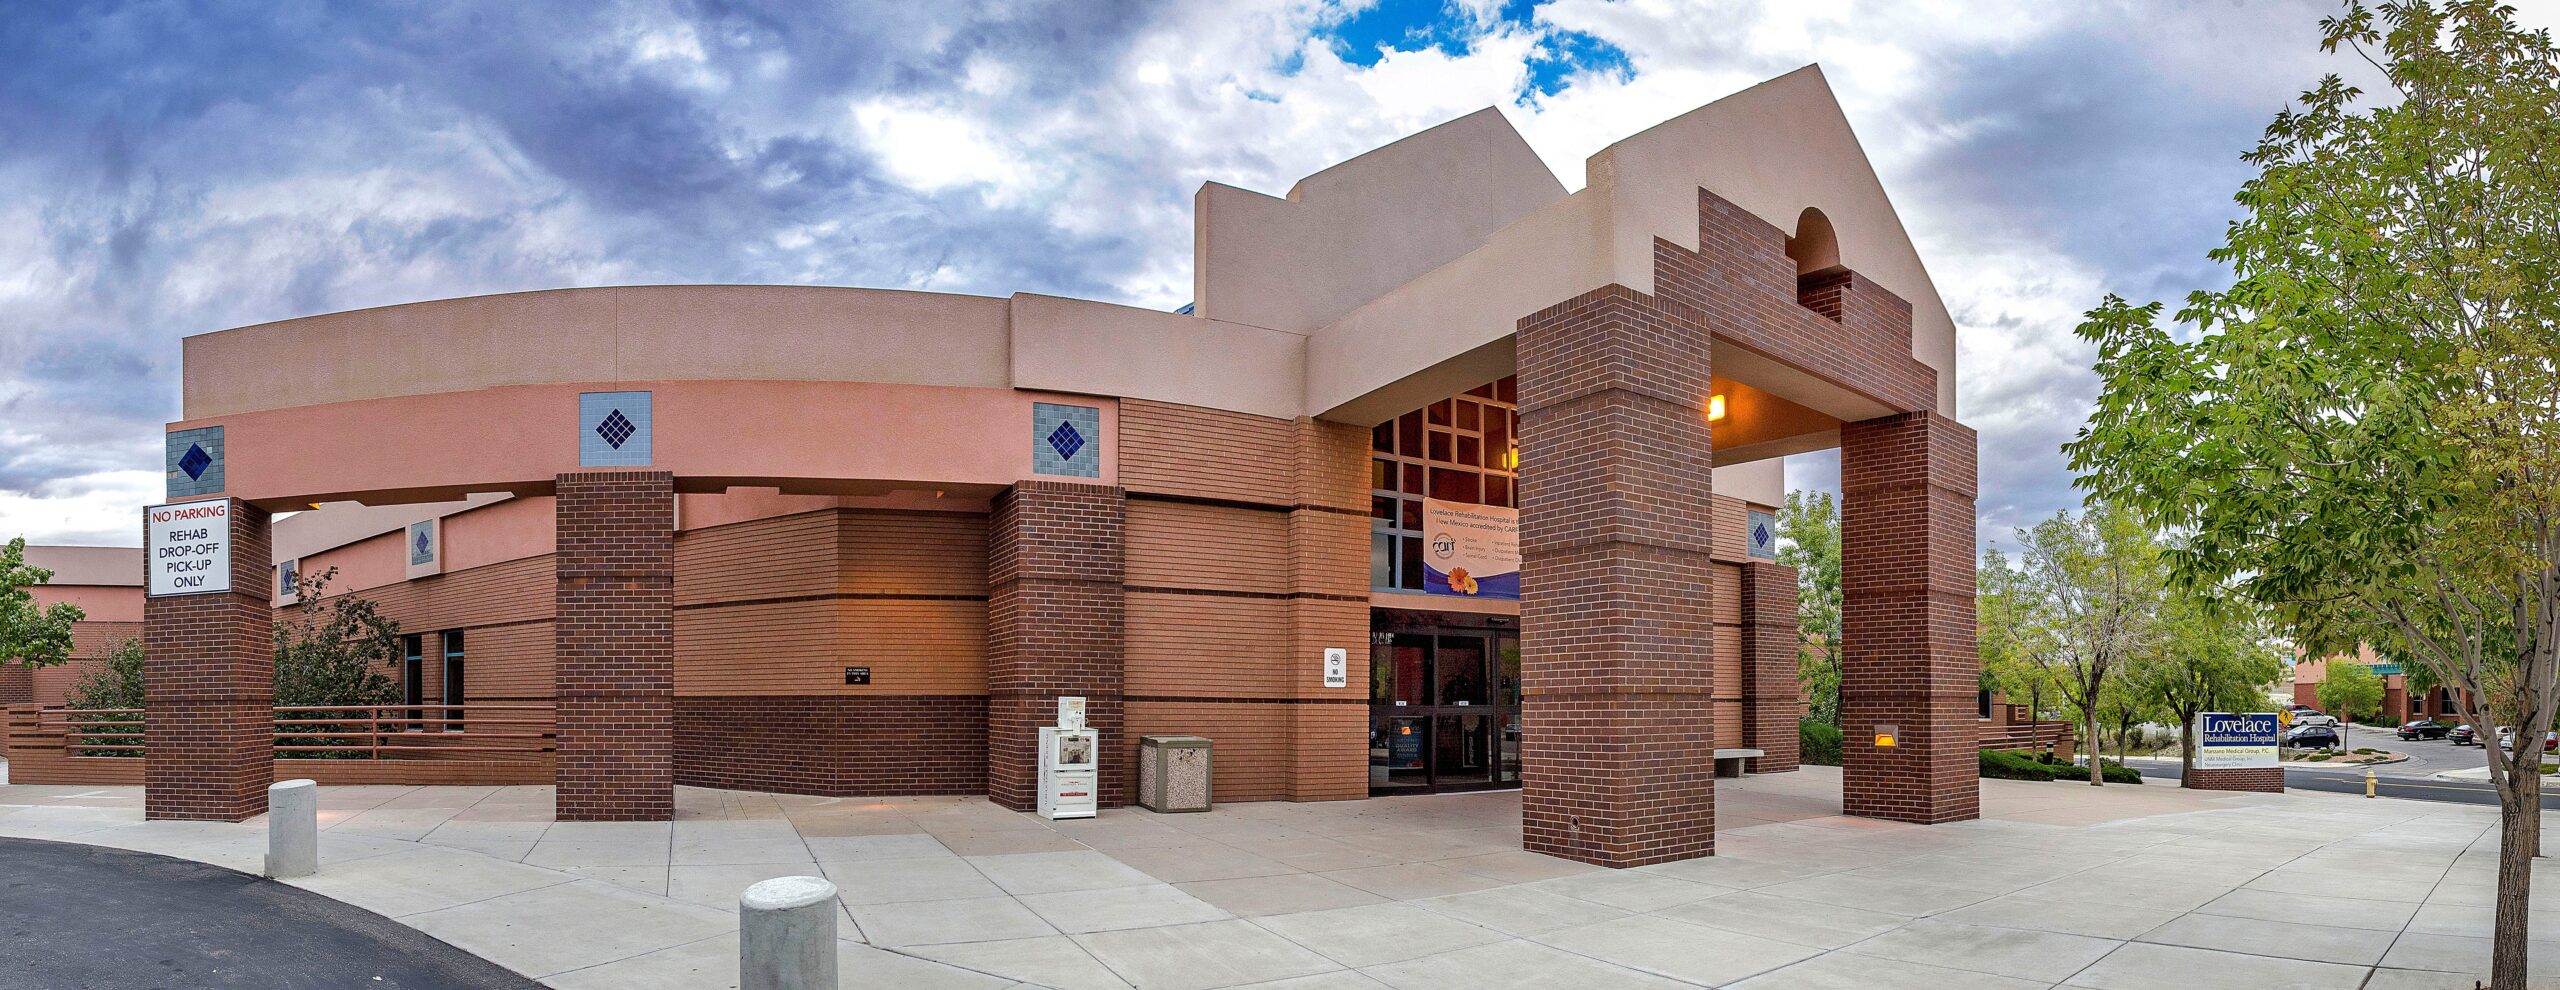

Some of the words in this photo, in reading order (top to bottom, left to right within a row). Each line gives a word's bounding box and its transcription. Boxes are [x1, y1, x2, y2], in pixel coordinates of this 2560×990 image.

[152, 511, 171, 523] NO
[174, 505, 225, 521] PARKING
[1430, 509, 1454, 517] Lovelace
[1455, 511, 1489, 521] Rehabilitation
[1490, 516, 1510, 524] Hospital
[1450, 520, 1469, 528] Mexico
[170, 528, 208, 542] REHAB
[159, 542, 219, 558] DROP-OFF
[167, 559, 212, 573] PICK-UP
[174, 575, 205, 588] ONLY
[2204, 716, 2271, 733] Lovelace
[2204, 734, 2248, 742] Rehabilitation
[2250, 734, 2276, 744] Hospital
